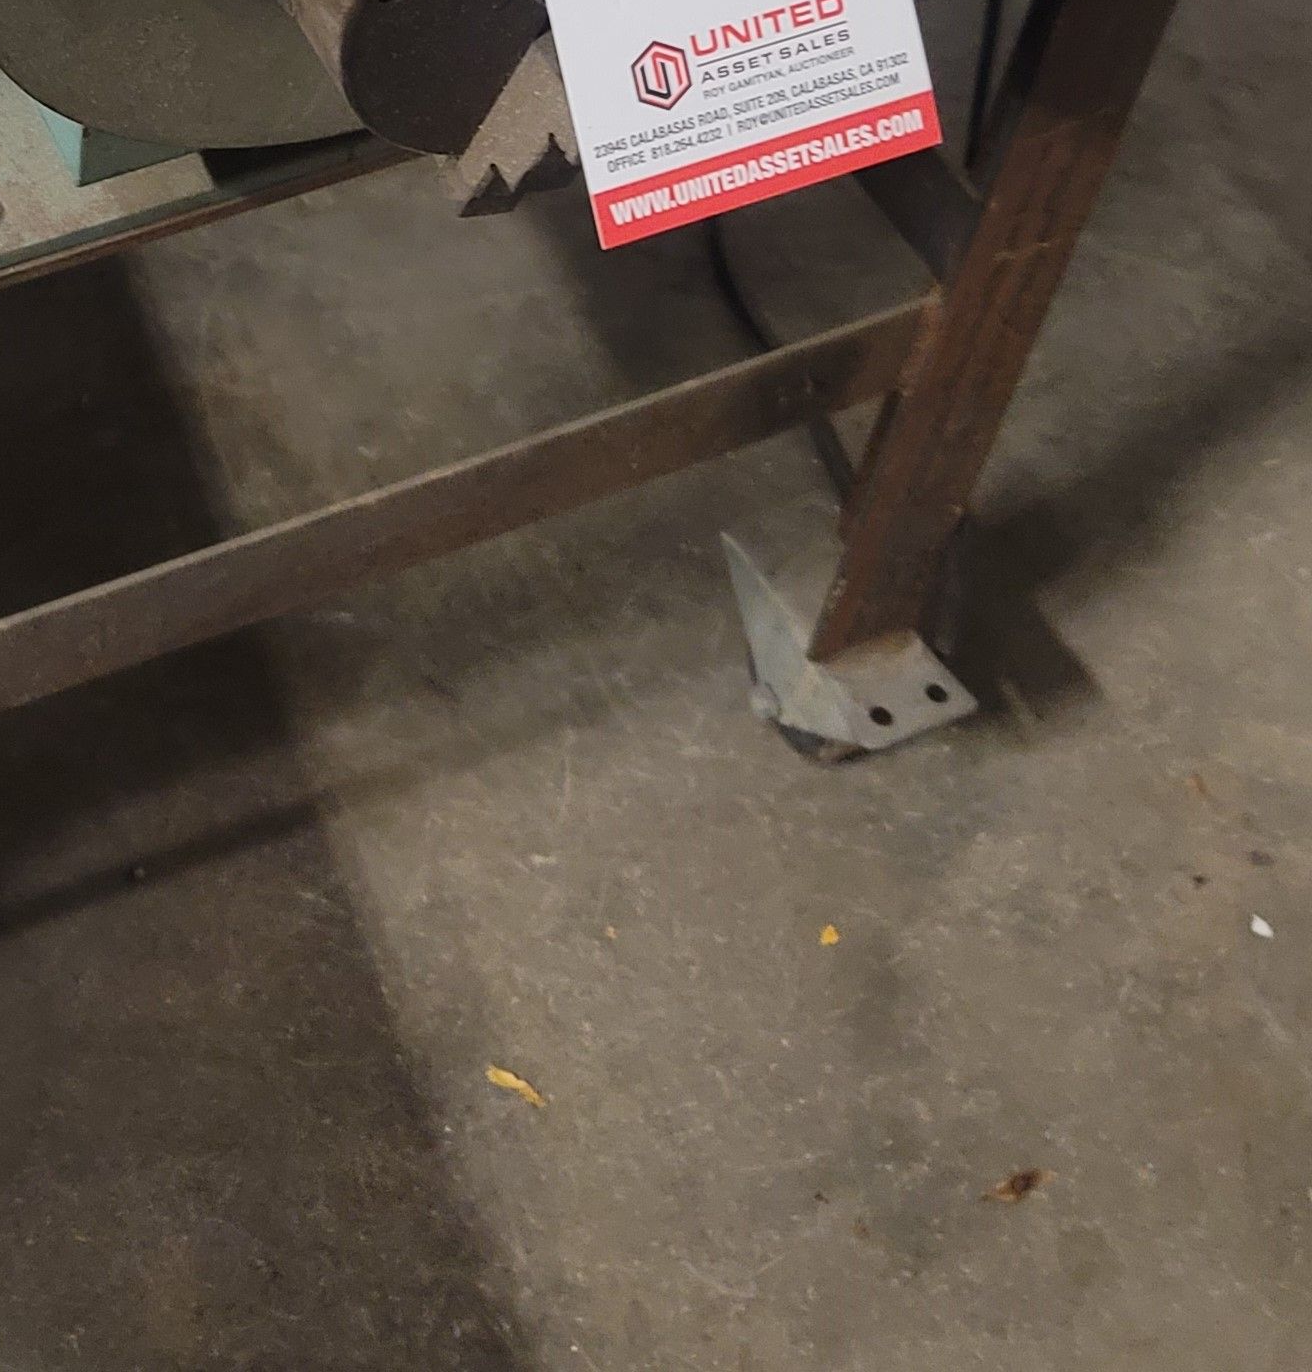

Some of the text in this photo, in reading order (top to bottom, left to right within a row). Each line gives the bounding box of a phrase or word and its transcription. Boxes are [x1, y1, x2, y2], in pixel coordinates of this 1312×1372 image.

[701, 29, 851, 84] ASSET SALES
[703, 86, 725, 100] ROY
[788, 46, 855, 74] AUCTIONEER
[593, 138, 628, 159] 23945
[630, 117, 696, 147] CALABASAS
[697, 107, 731, 127] ROAD,
[733, 95, 766, 116] SUITE
[859, 62, 875, 77] CA
[607, 150, 647, 173] OFFICE
[736, 72, 901, 132] ROY@UNITEDASSETSALES.COM
[609, 109, 924, 225] WWW.UNITEDASSETSALES.COM
